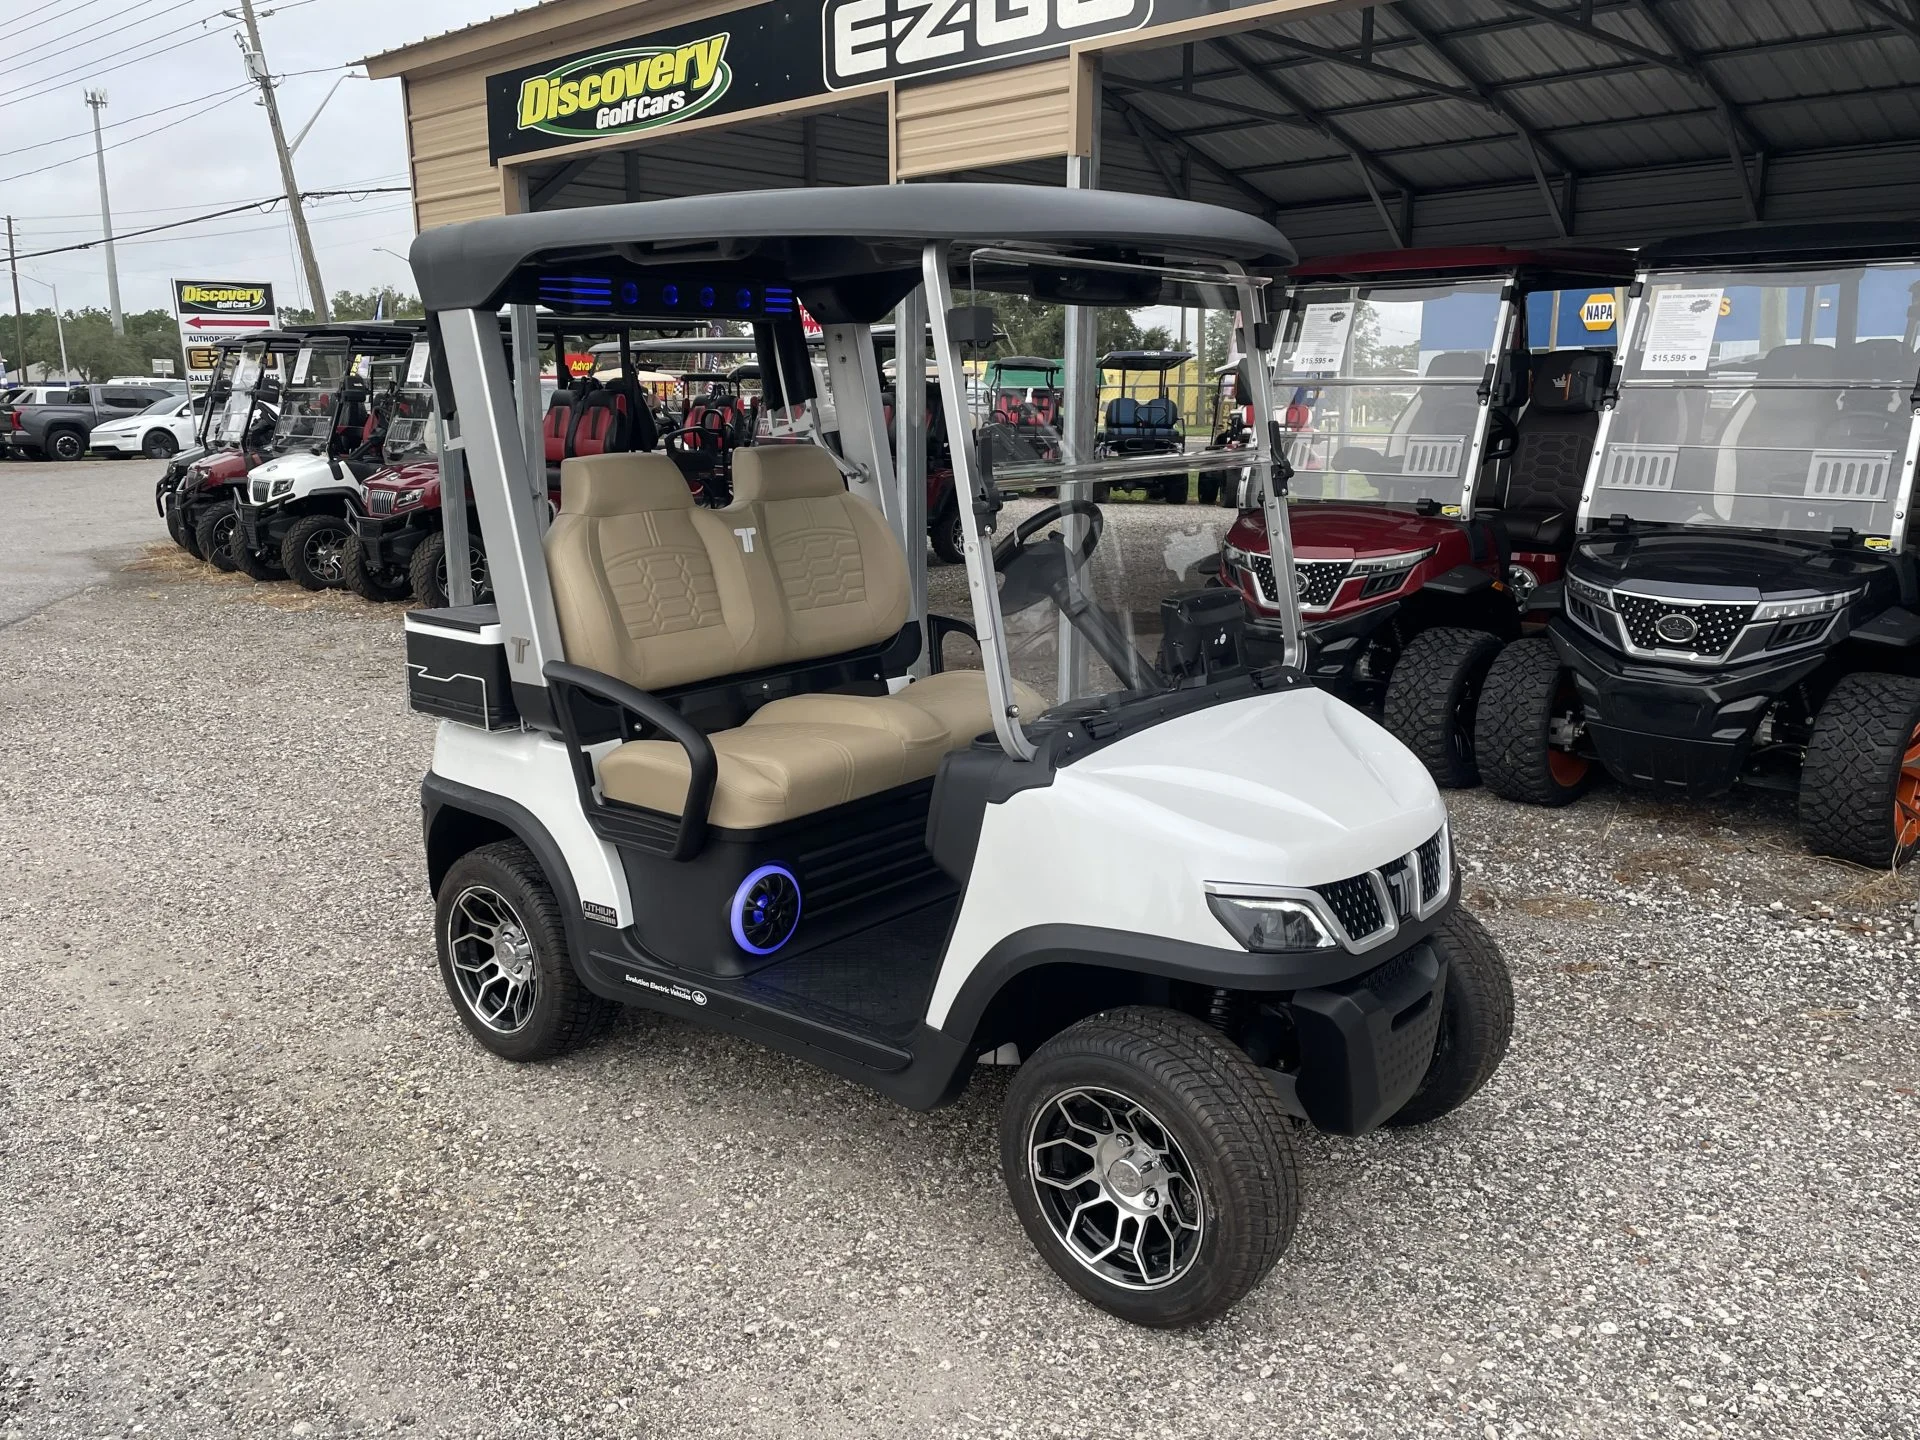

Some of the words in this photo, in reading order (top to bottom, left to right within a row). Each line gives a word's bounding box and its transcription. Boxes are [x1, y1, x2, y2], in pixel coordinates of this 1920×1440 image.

[521, 36, 725, 126] Discovery
[596, 98, 637, 129] Golf
[636, 90, 685, 118] Cars
[183, 286, 262, 303] Discovery
[1586, 304, 1613, 320] NAPA
[1301, 357, 1327, 365] $15,595
[1652, 354, 1687, 363] $15,595
[583, 901, 616, 918] LITHIUM
[625, 973, 650, 987] Evolution
[650, 982, 670, 993] Electric
[670, 988, 691, 1001] Vehicles
